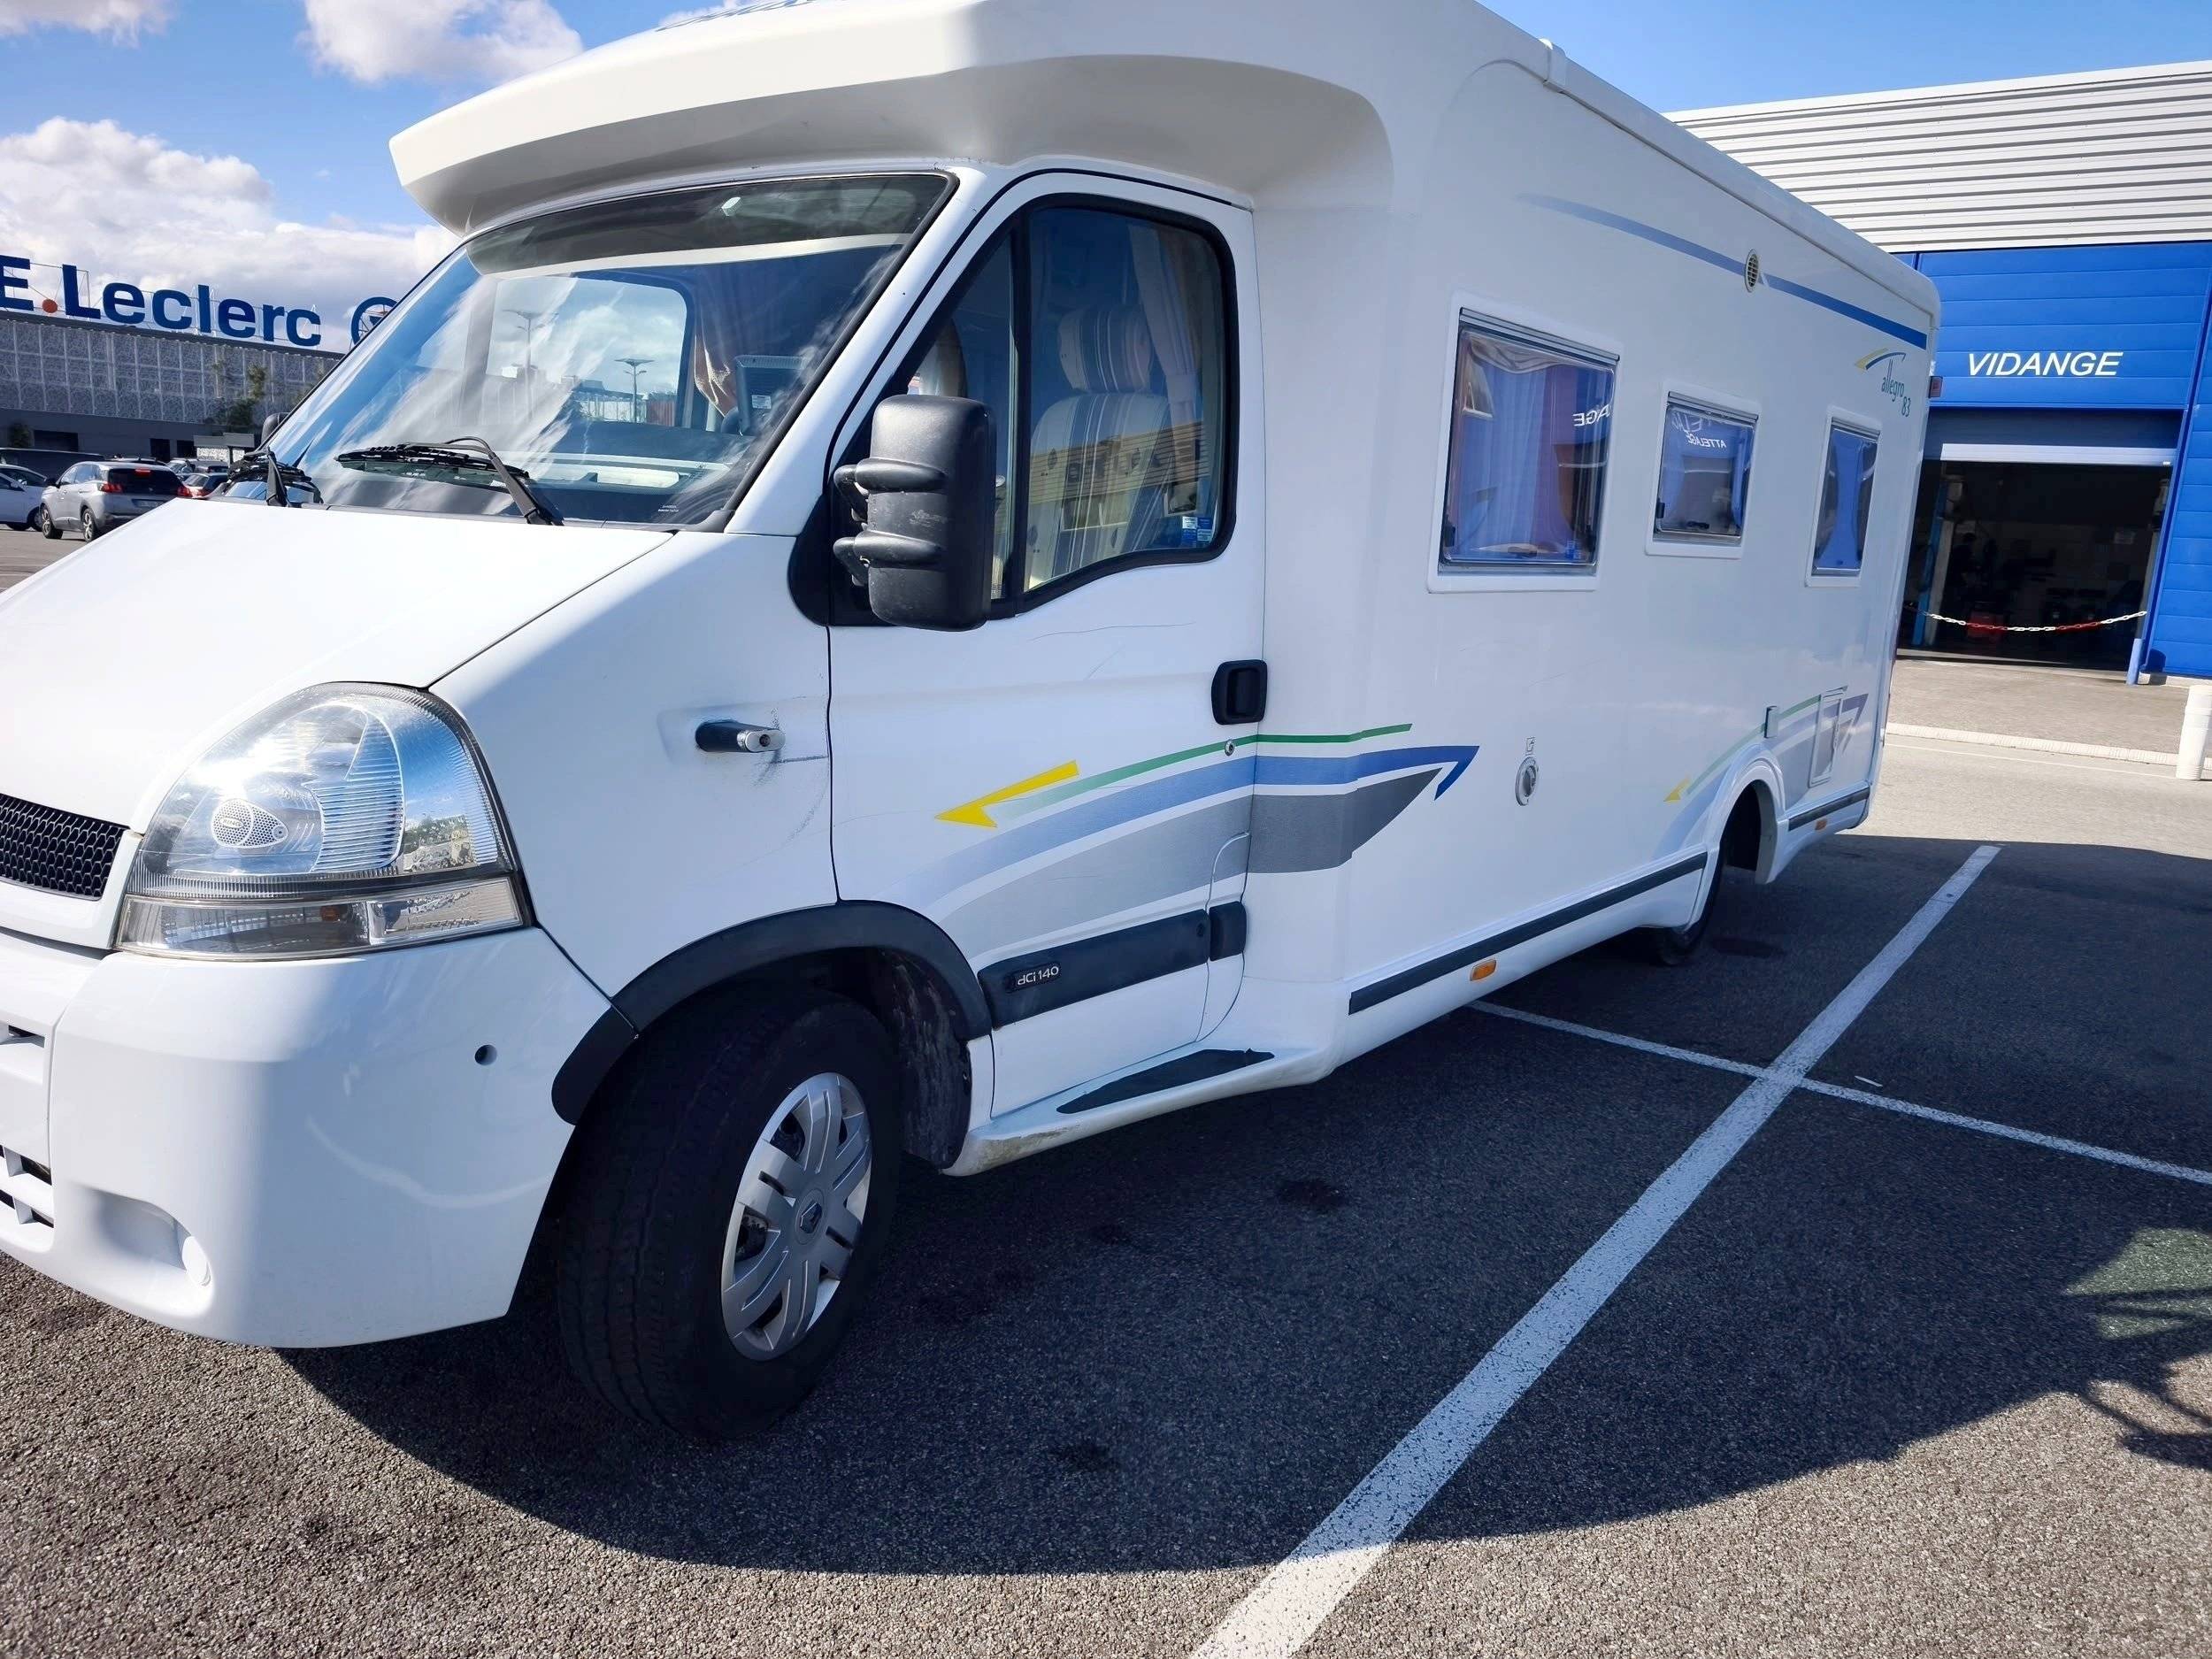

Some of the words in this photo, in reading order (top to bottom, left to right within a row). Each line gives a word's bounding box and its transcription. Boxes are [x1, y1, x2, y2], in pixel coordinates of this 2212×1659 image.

[1969, 351, 2124, 376] VIDANGE
[1881, 358, 1905, 402] allegro
[1901, 396, 1911, 417] 83
[1038, 965, 1059, 979] 140
